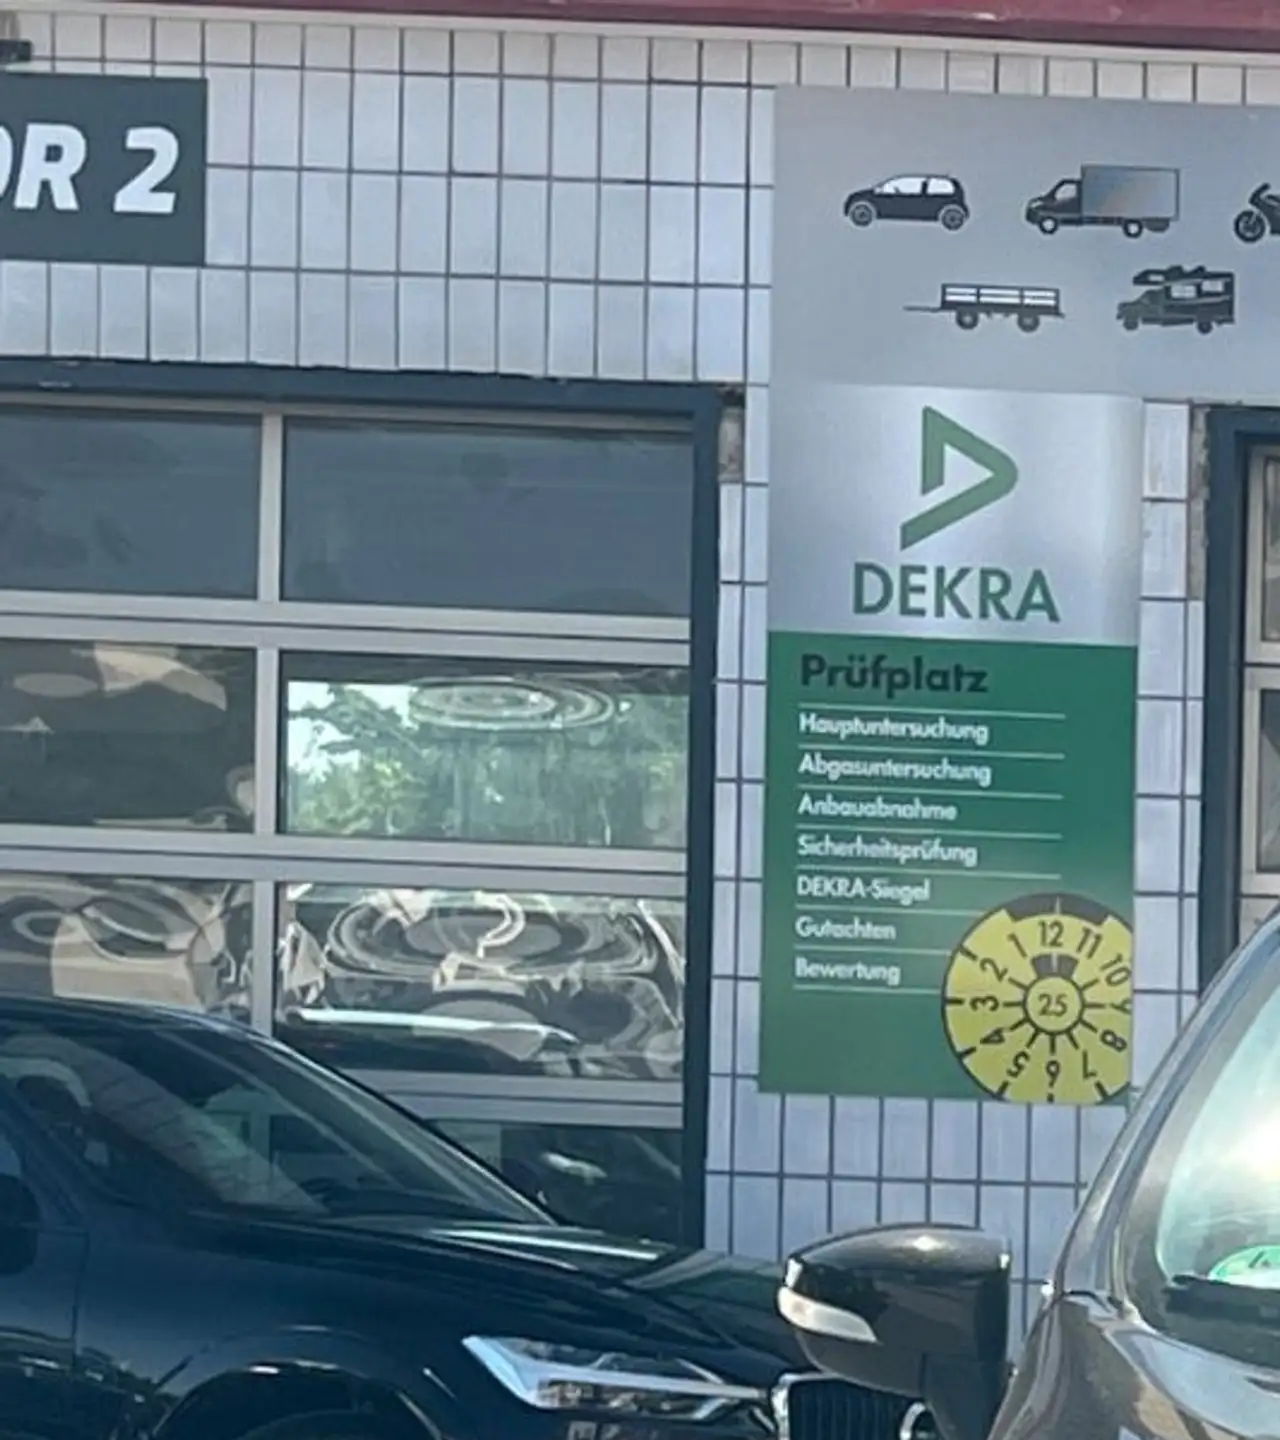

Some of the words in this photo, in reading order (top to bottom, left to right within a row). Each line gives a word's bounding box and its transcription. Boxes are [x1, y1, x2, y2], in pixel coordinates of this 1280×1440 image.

[0, 122, 86, 211] R
[113, 126, 179, 214] 2
[852, 561, 1061, 623] DEKRA
[801, 653, 989, 699] Prüfplatz
[799, 712, 989, 746] Hauptuntersuchung
[798, 752, 992, 788] Abgasuntersuchung
[798, 793, 958, 821] Anbauabnahme
[797, 833, 979, 868] Sicherheitsprüfung
[796, 874, 931, 906] DEKRA-Siegel
[795, 915, 897, 940] Gutachten
[1038, 920, 1064, 947] 12
[1007, 933, 1027, 958] 1
[1077, 926, 1102, 959] 11
[794, 957, 901, 987] Bewertung
[979, 958, 1008, 982] 2
[1100, 954, 1132, 987] 10
[969, 995, 999, 1011] 3
[1038, 993, 1068, 1017] 25
[980, 1027, 1006, 1044] 4
[1101, 1029, 1127, 1053] 8
[1006, 1051, 1030, 1078] 5
[1082, 1051, 1097, 1080] 7
